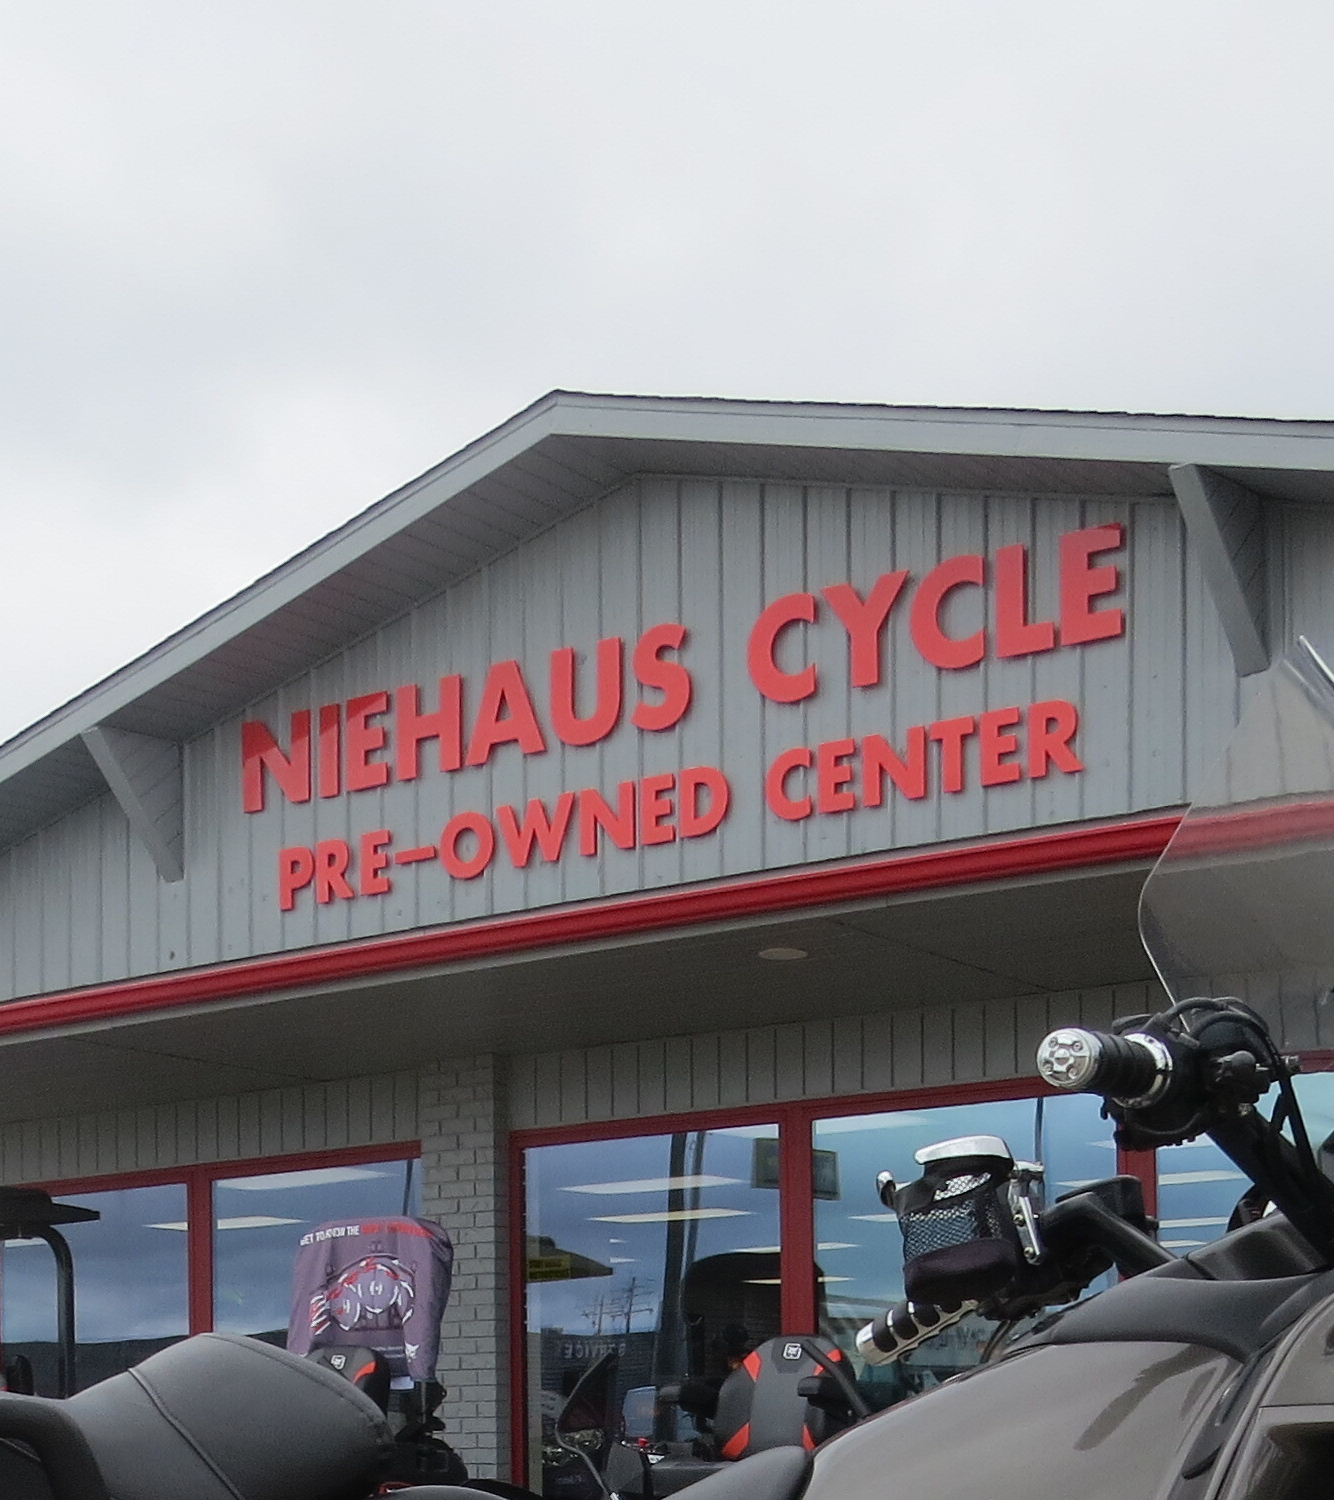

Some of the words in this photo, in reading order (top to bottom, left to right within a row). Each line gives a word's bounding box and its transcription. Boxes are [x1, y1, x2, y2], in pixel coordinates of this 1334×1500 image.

[241, 622, 694, 813] NIEHAUS
[746, 522, 1125, 704] CYCLE
[278, 765, 732, 911] PRE-OWNED
[763, 699, 1084, 822] CENTER
[346, 1224, 360, 1237] THE
